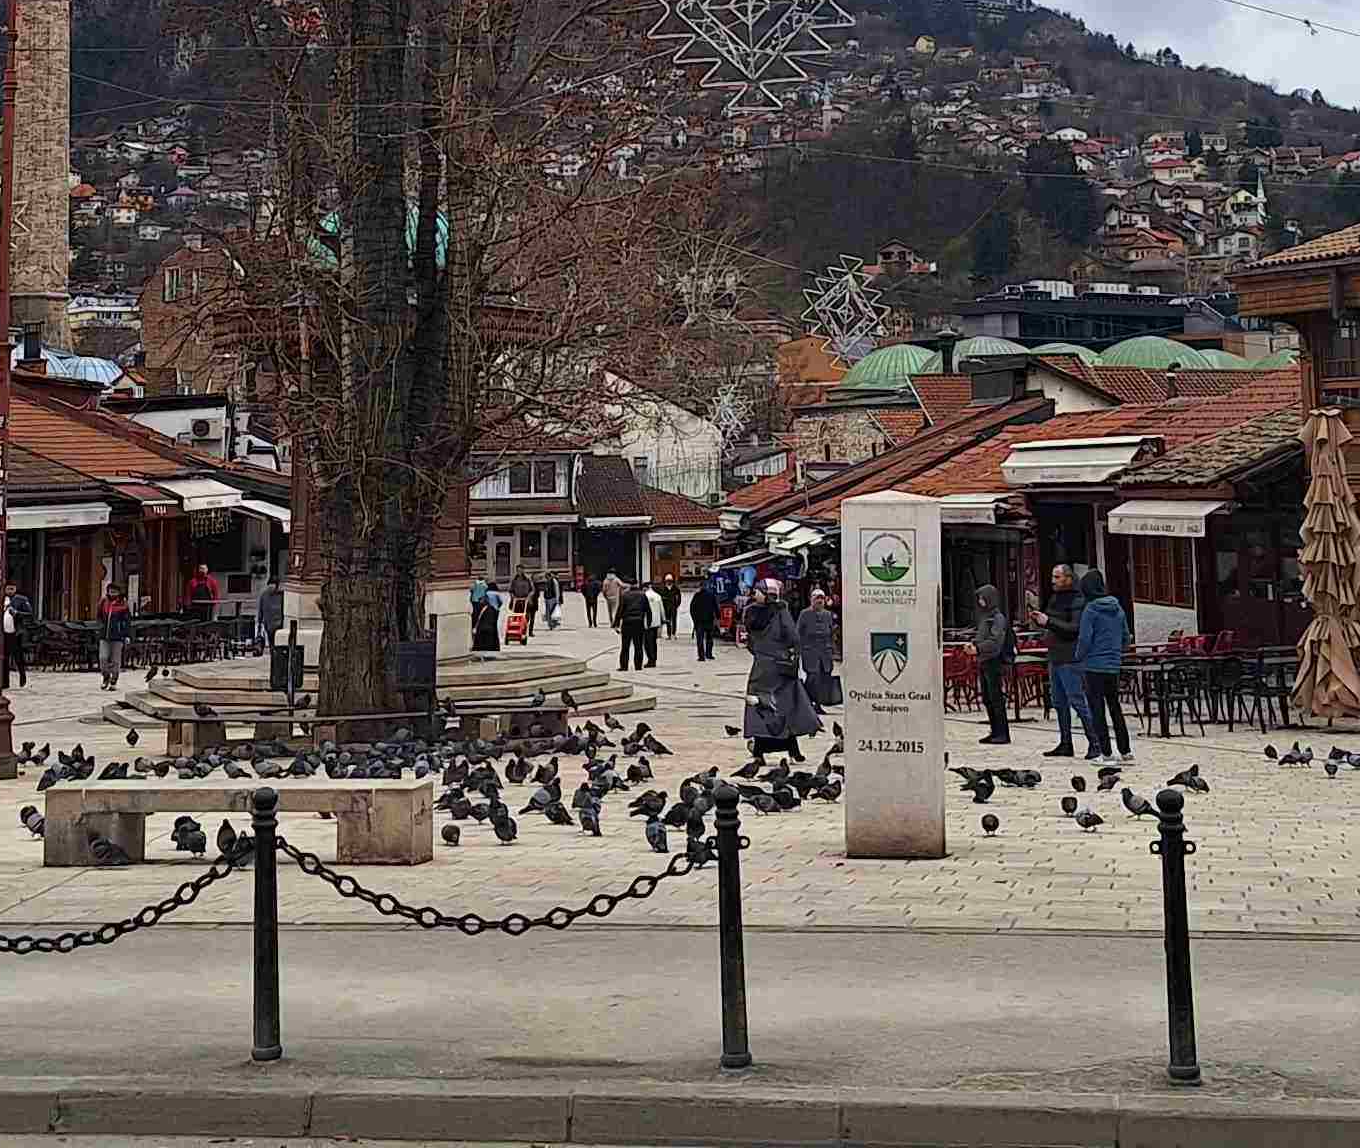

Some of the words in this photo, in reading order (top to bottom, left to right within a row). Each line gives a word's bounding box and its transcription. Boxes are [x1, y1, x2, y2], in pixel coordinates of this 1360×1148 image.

[908, 691, 931, 701] Grad
[871, 703, 909, 715] Sarajevo
[857, 739, 925, 754] 24.12.2015
